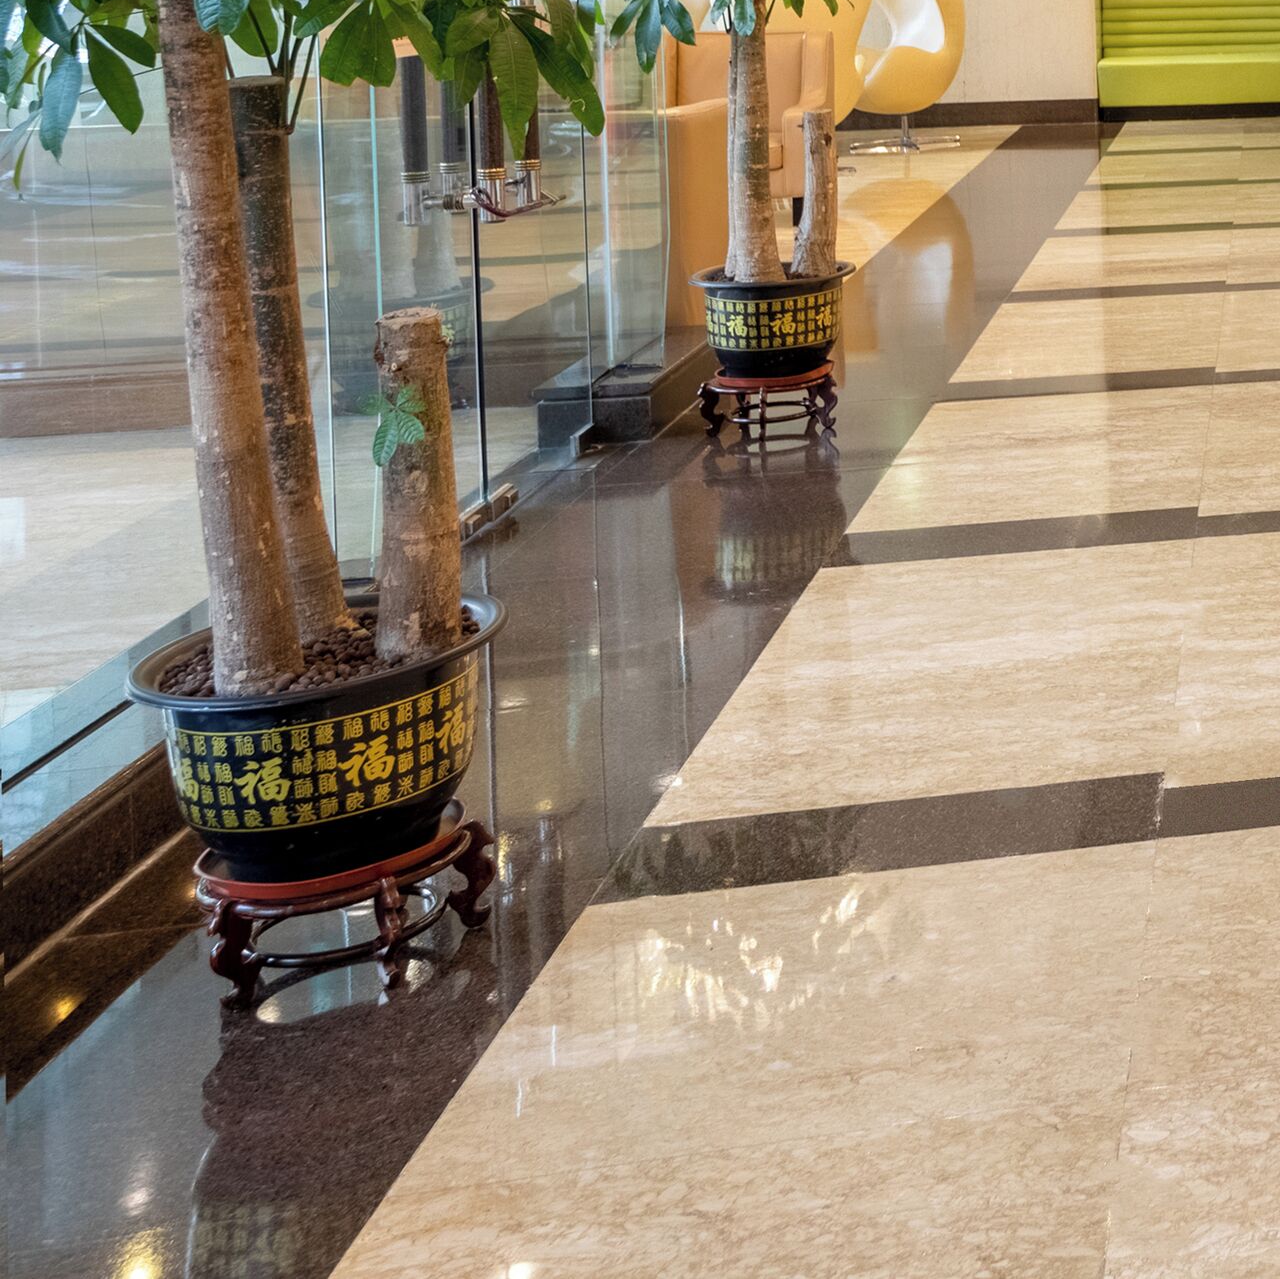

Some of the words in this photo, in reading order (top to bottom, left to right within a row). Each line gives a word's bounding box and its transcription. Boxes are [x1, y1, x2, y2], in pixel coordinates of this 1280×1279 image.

[726, 315, 748, 337] 福
[770, 312, 796, 335] 福
[816, 304, 832, 328] 福
[436, 701, 466, 754] 福
[338, 735, 396, 787] 福
[234, 757, 292, 805] 福
